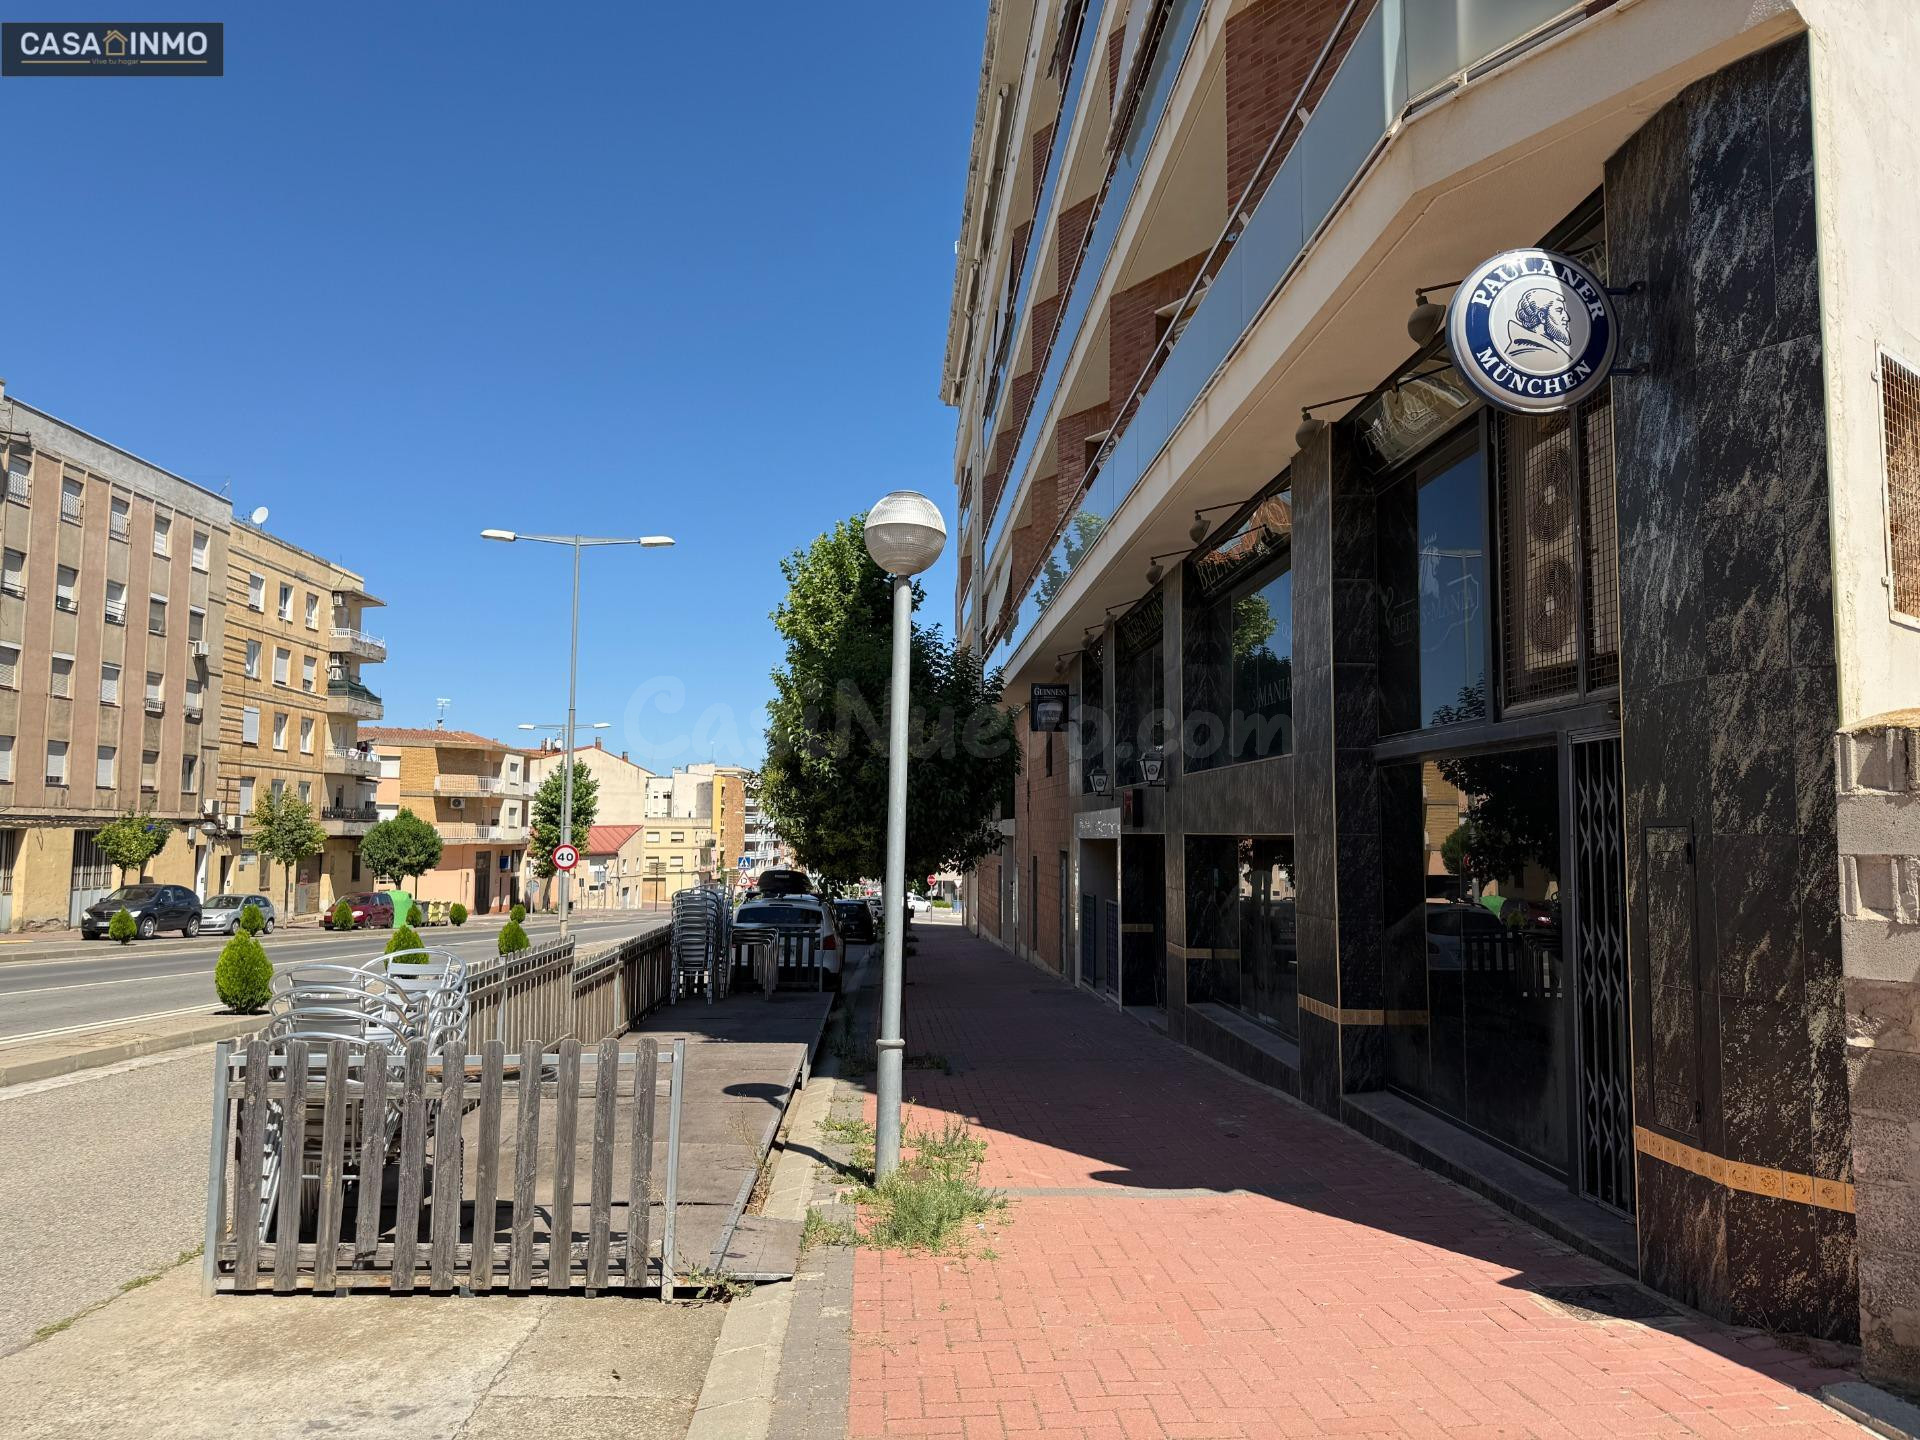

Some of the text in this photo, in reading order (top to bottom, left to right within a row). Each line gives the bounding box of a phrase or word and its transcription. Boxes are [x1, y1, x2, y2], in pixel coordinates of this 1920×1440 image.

[1471, 257, 1604, 321] PAULANER
[1476, 347, 1592, 395] MÜNCHEN
[1033, 687, 1067, 697] GUINNESS
[557, 852, 574, 862] 40
